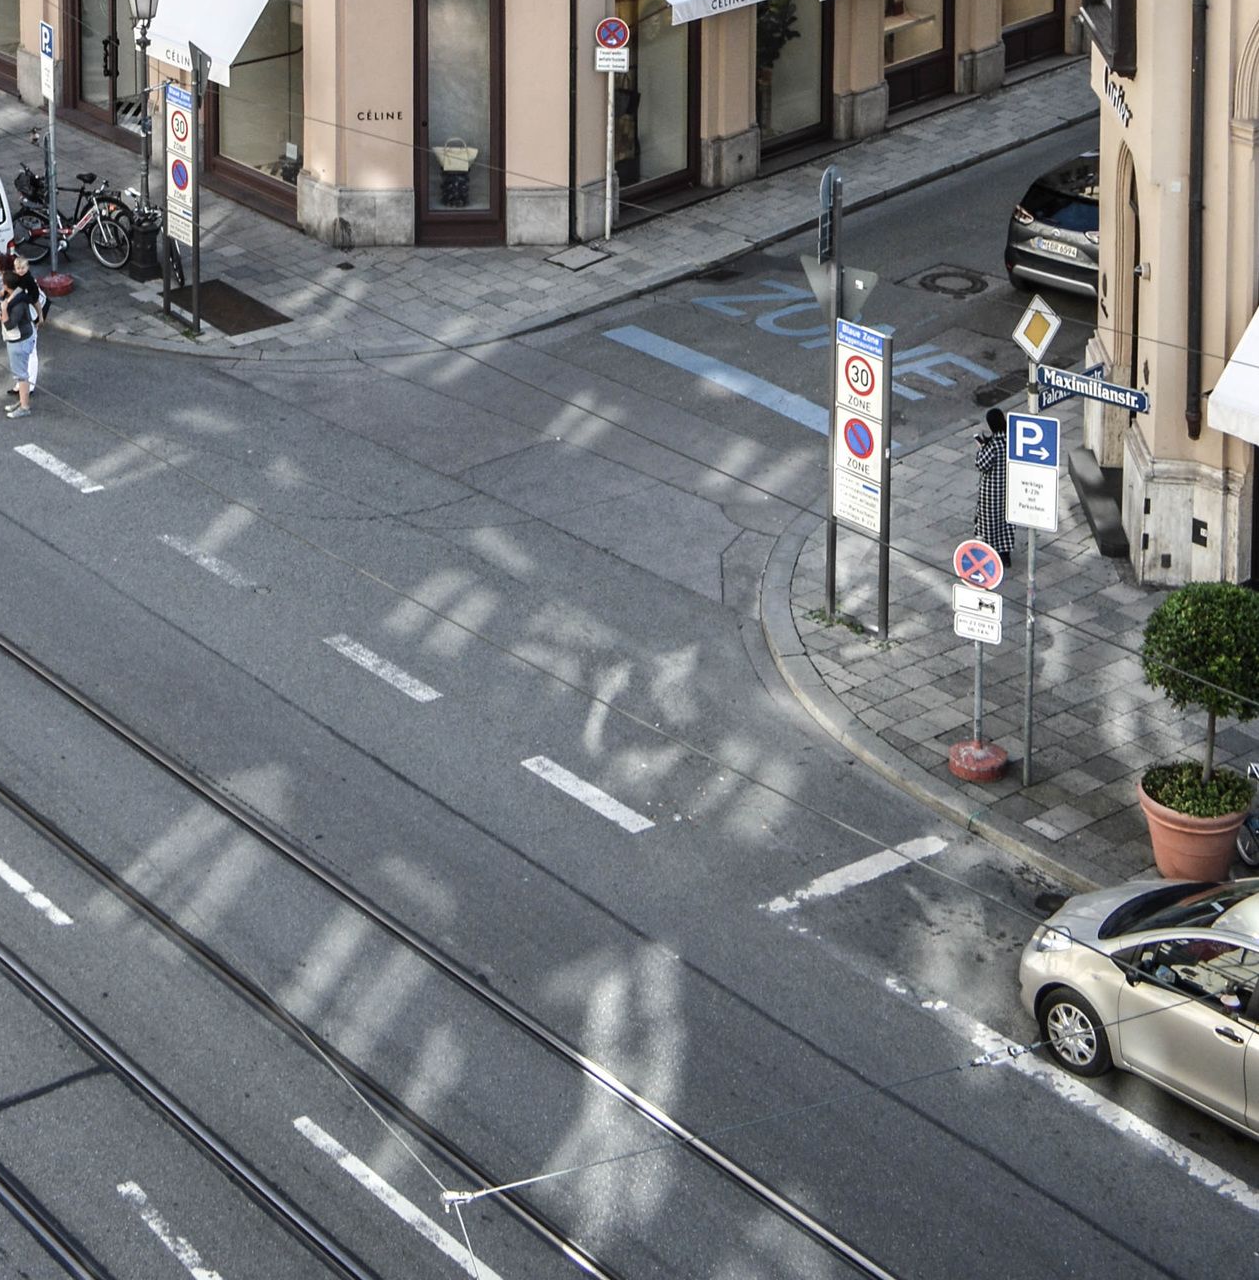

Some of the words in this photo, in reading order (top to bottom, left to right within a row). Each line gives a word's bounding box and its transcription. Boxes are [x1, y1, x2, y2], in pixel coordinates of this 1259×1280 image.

[166, 47, 190, 67] CÉLIN
[1103, 64, 1133, 128] Cartier
[357, 109, 403, 121] CÉLINE
[175, 118, 185, 135] 30
[173, 141, 187, 155] ZONE
[173, 189, 187, 203] ZONE
[842, 323, 861, 338] Blaue
[863, 332, 879, 345] Zone
[851, 365, 869, 387] 30
[1044, 368, 1139, 408] Maximilianstr.
[848, 394, 871, 413] ZONE
[1016, 420, 1044, 457] P
[847, 456, 870, 475] ZONE
